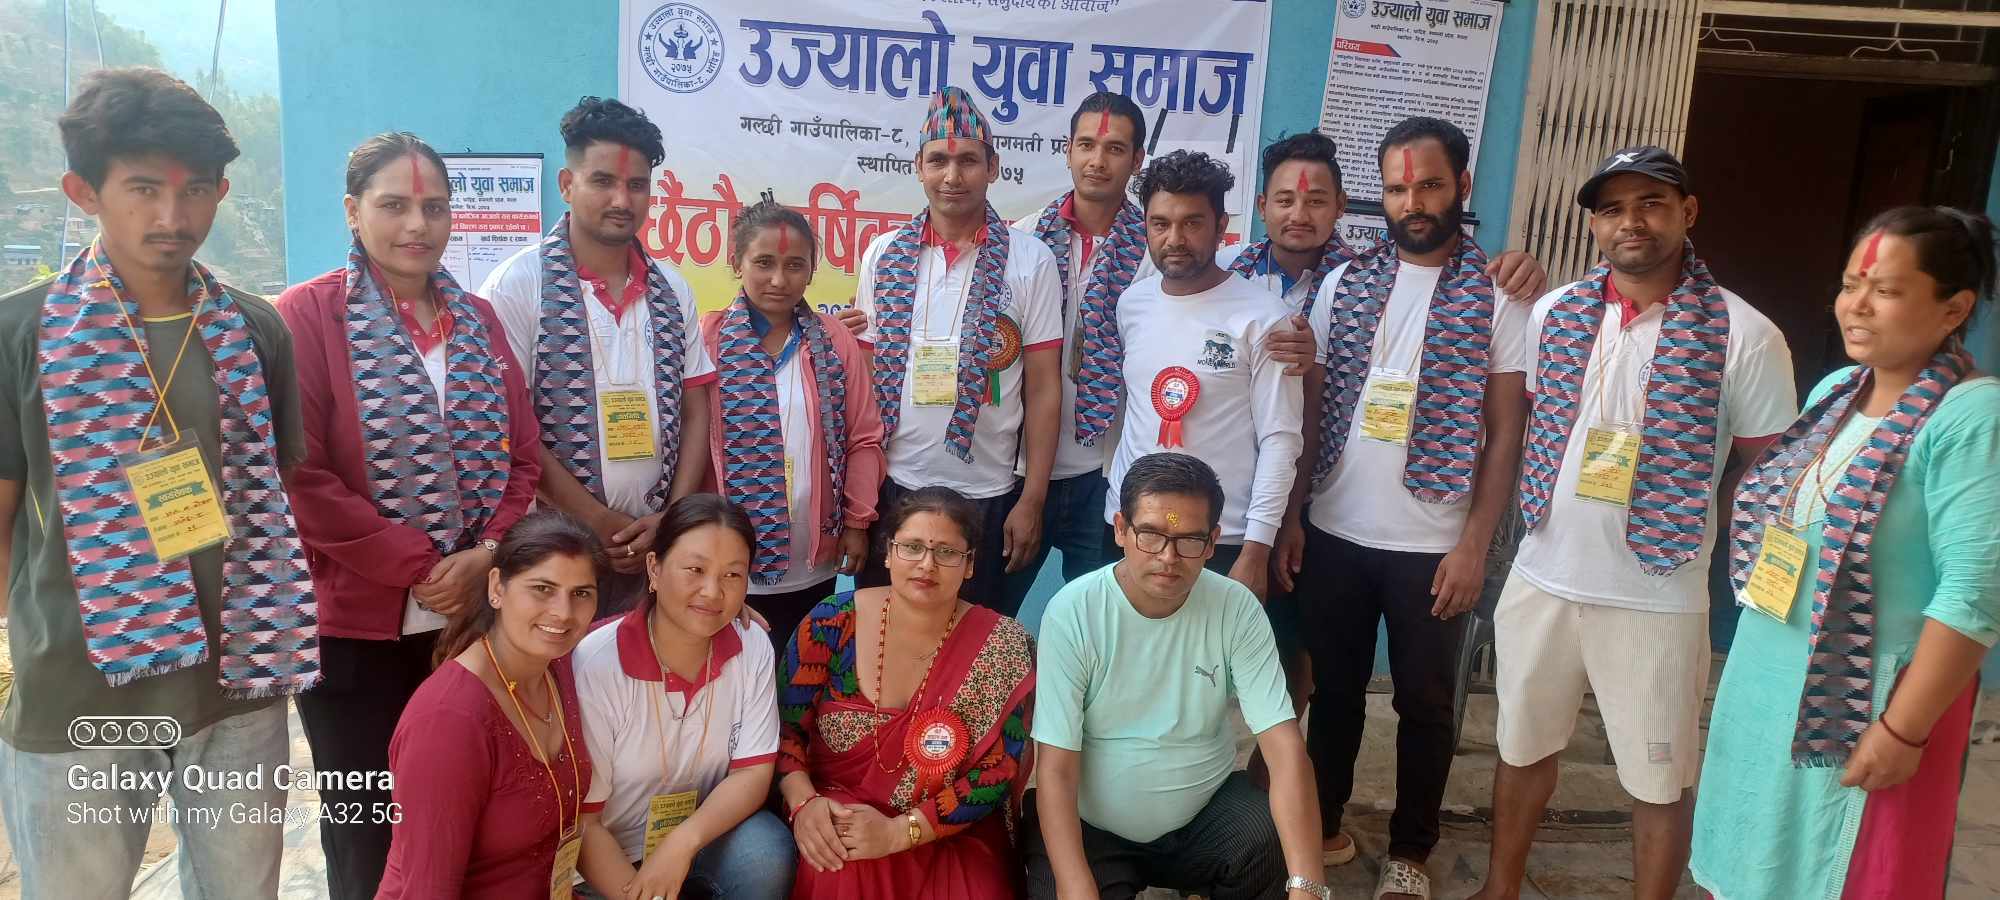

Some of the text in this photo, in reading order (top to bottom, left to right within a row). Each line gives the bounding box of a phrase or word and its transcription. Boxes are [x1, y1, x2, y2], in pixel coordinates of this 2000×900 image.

[1371, 1, 1493, 31] उज्यालो युवा समाज
[738, 9, 1254, 123] उज्यालो युवा समाज
